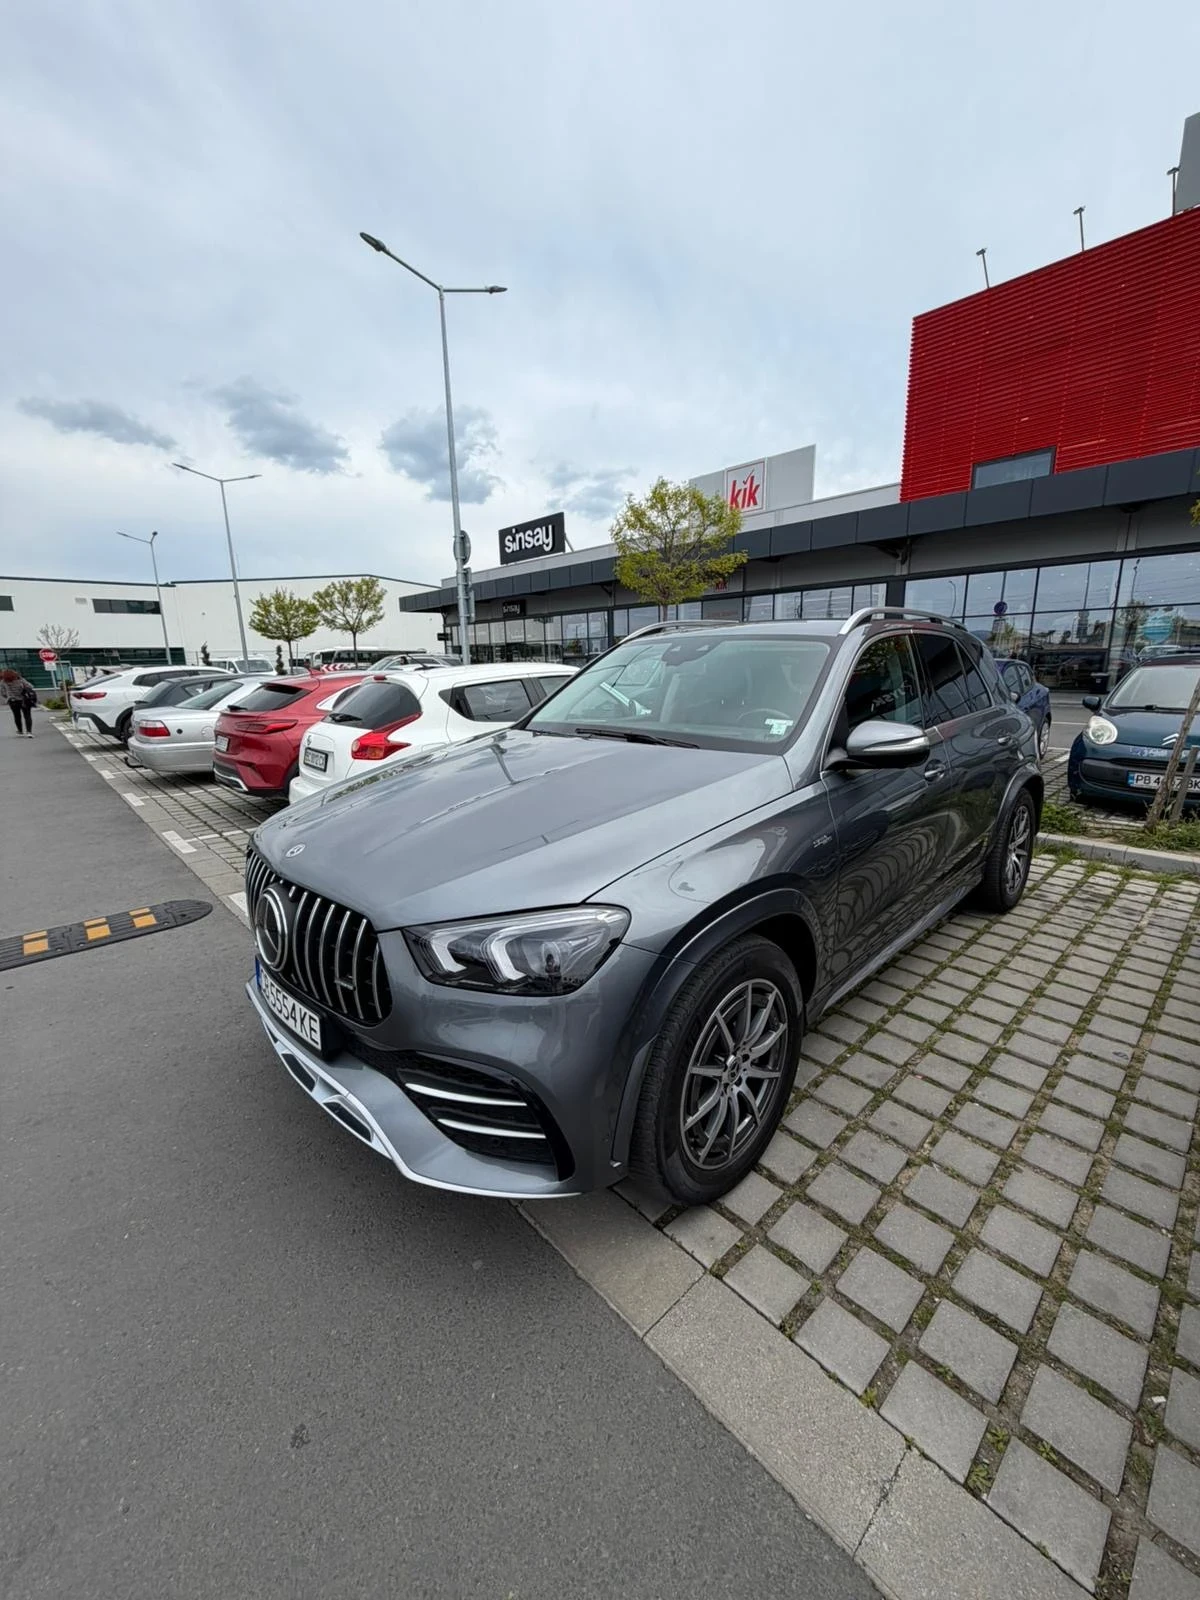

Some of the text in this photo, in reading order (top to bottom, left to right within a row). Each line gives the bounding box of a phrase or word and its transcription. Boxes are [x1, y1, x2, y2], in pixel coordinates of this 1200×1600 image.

[505, 524, 552, 553] sinsay
[1135, 774, 1151, 785] PB
[270, 982, 298, 1029] 5554
[299, 1007, 319, 1046] KE
